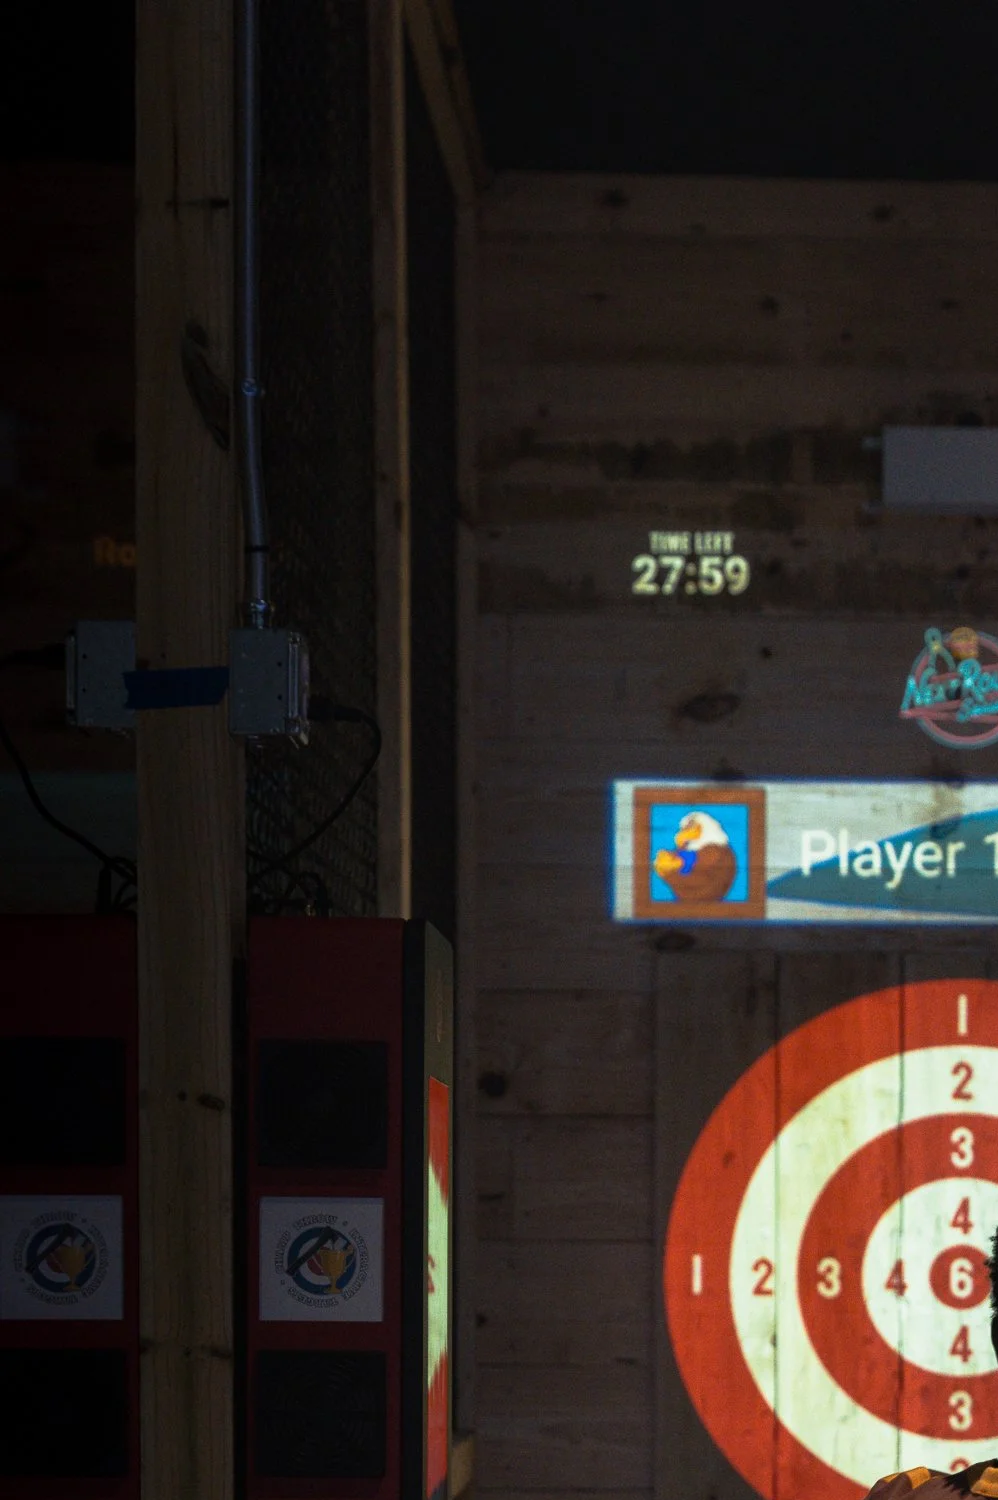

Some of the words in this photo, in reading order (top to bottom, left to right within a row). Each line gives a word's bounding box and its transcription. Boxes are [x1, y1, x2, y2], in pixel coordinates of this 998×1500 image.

[631, 554, 750, 596] 27:59
[801, 828, 966, 890] Player
[951, 1061, 974, 1100] 2
[950, 1127, 974, 1169] 3
[950, 1197, 973, 1234] 4
[752, 1257, 774, 1297] 2
[817, 1257, 841, 1298] 3
[884, 1258, 908, 1297] 4
[950, 1257, 974, 1298] 6
[950, 1324, 974, 1363] 4
[949, 1391, 973, 1431] 3
